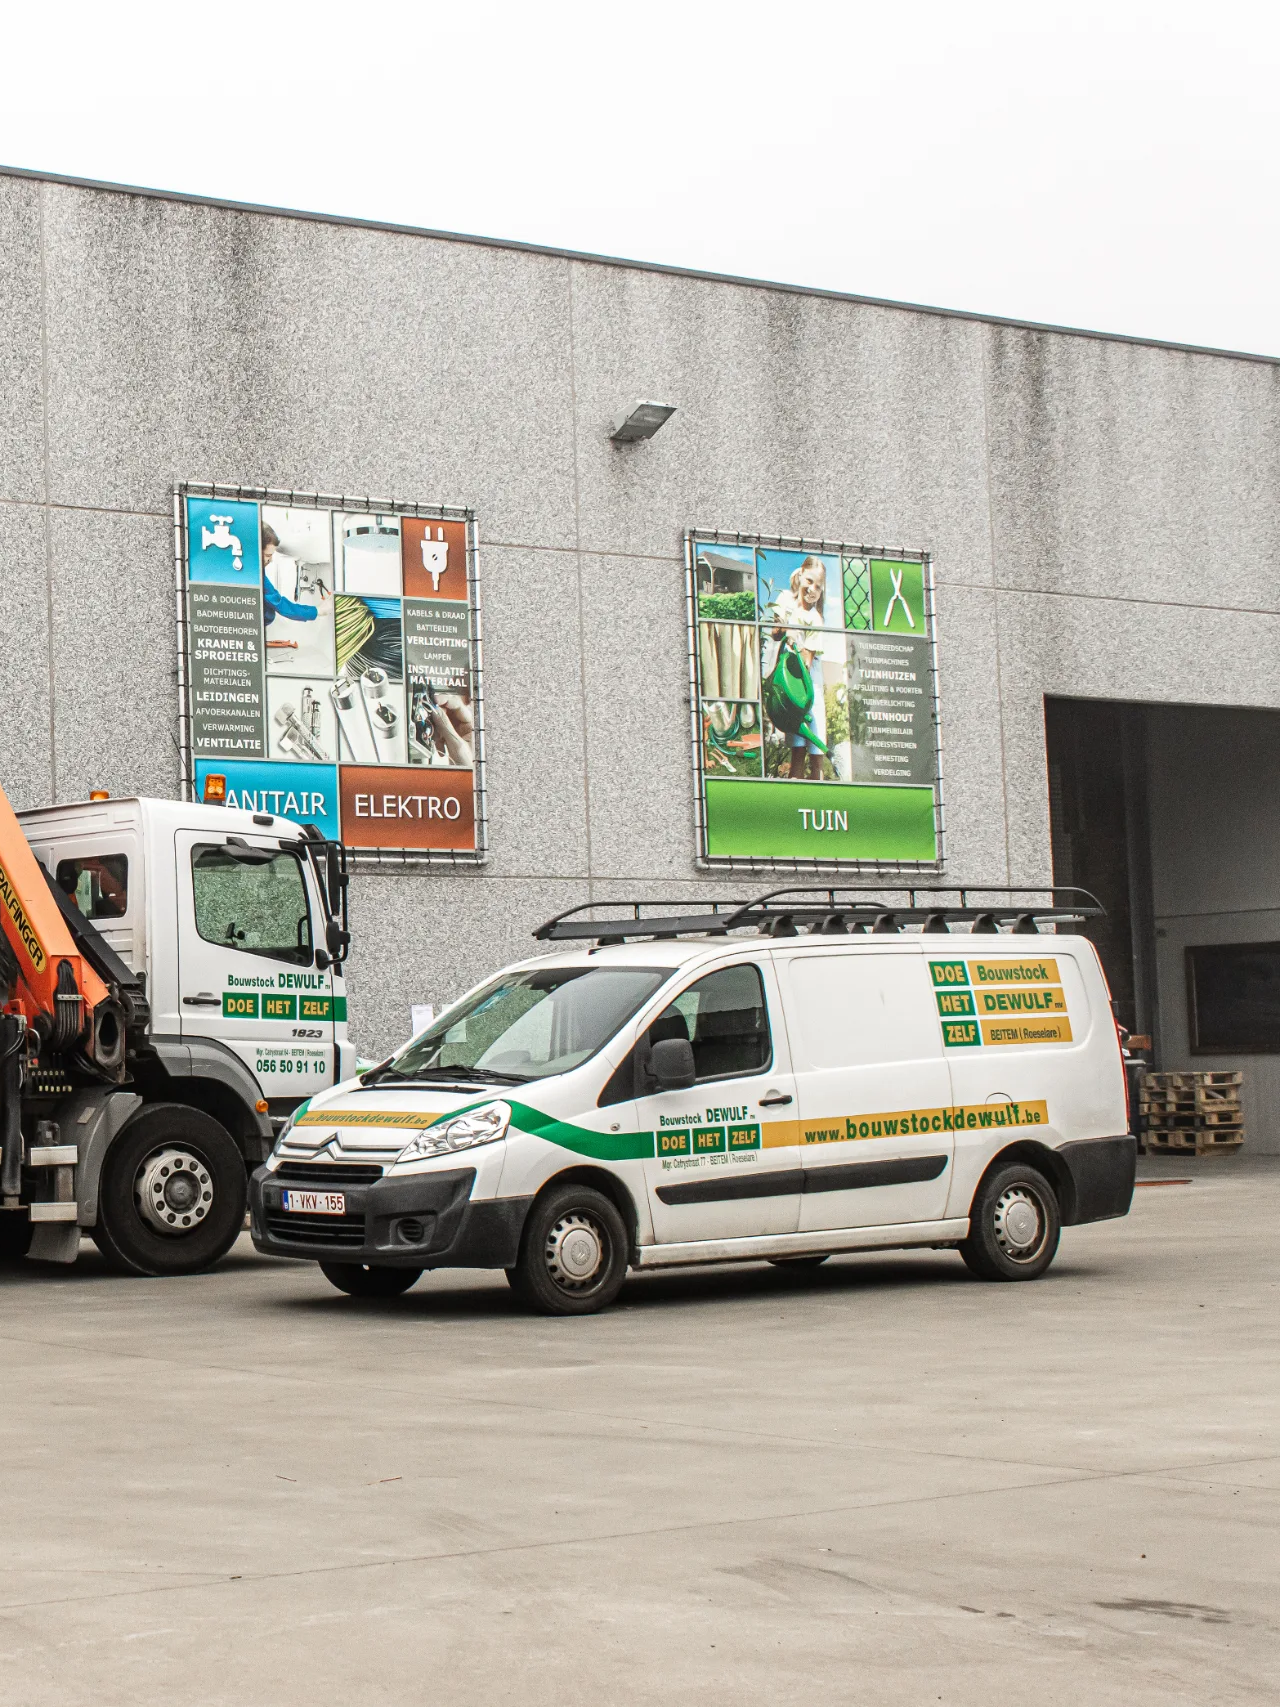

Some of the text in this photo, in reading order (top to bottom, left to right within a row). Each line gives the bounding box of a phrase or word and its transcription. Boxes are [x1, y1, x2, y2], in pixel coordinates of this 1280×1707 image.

[193, 594, 257, 606] BAD & DOUCHES
[197, 610, 254, 620] BADMEUBILAIR
[407, 609, 433, 618] KABELS
[442, 612, 466, 620] DRAAD
[193, 624, 259, 636] BADTOEBEHOREN
[417, 624, 458, 633] BATTERIJEN
[197, 638, 255, 651] KRANEN &
[406, 635, 468, 648] VERLICHTING
[195, 650, 259, 662] SPROEIERS
[424, 653, 451, 661] LAMPEN
[865, 657, 909, 666] TUINMACHINES
[203, 668, 250, 677] DICHTINGS-
[408, 664, 468, 677] INSTALLATIE-
[859, 669, 916, 681] TUINHUIZEN
[203, 677, 251, 687] MATERIALEN
[410, 676, 467, 688] MATERIAAL
[196, 691, 259, 704] LEIDINGEN
[863, 698, 916, 708] TUINVERLICHTING
[196, 708, 260, 718] AFVOERKANALEN
[866, 711, 914, 722] TUINHOUT
[202, 723, 255, 733] VERWARMING
[867, 727, 913, 735] TUINMEUBILAIR
[197, 737, 261, 749] VENTILATIE
[875, 755, 909, 763] BEMESTING
[874, 769, 911, 777] VERDELGING
[225, 789, 327, 816] ANITAIR
[355, 793, 462, 820] ELEKTRO
[797, 808, 848, 831] TUIN
[933, 964, 1049, 983] DOE Bouwstock
[228, 974, 275, 988] Bouwstock
[278, 973, 324, 989] DEWULF
[227, 998, 329, 1015] DOE HET ZELF
[940, 995, 970, 1012] HET
[984, 992, 1053, 1011] DEWULF
[292, 1029, 323, 1038] 1823
[946, 1025, 976, 1043] ZELF
[990, 1029, 1018, 1040] BEITEM
[256, 1059, 325, 1074] 056 50 91 10
[660, 1113, 702, 1126] Bouwstock
[706, 1106, 748, 1123] DEWULF
[804, 1102, 1041, 1143] www.bouwstockdewulf.be
[662, 1130, 756, 1150] DOE HET ZELF
[710, 1155, 728, 1165] BEITEM
